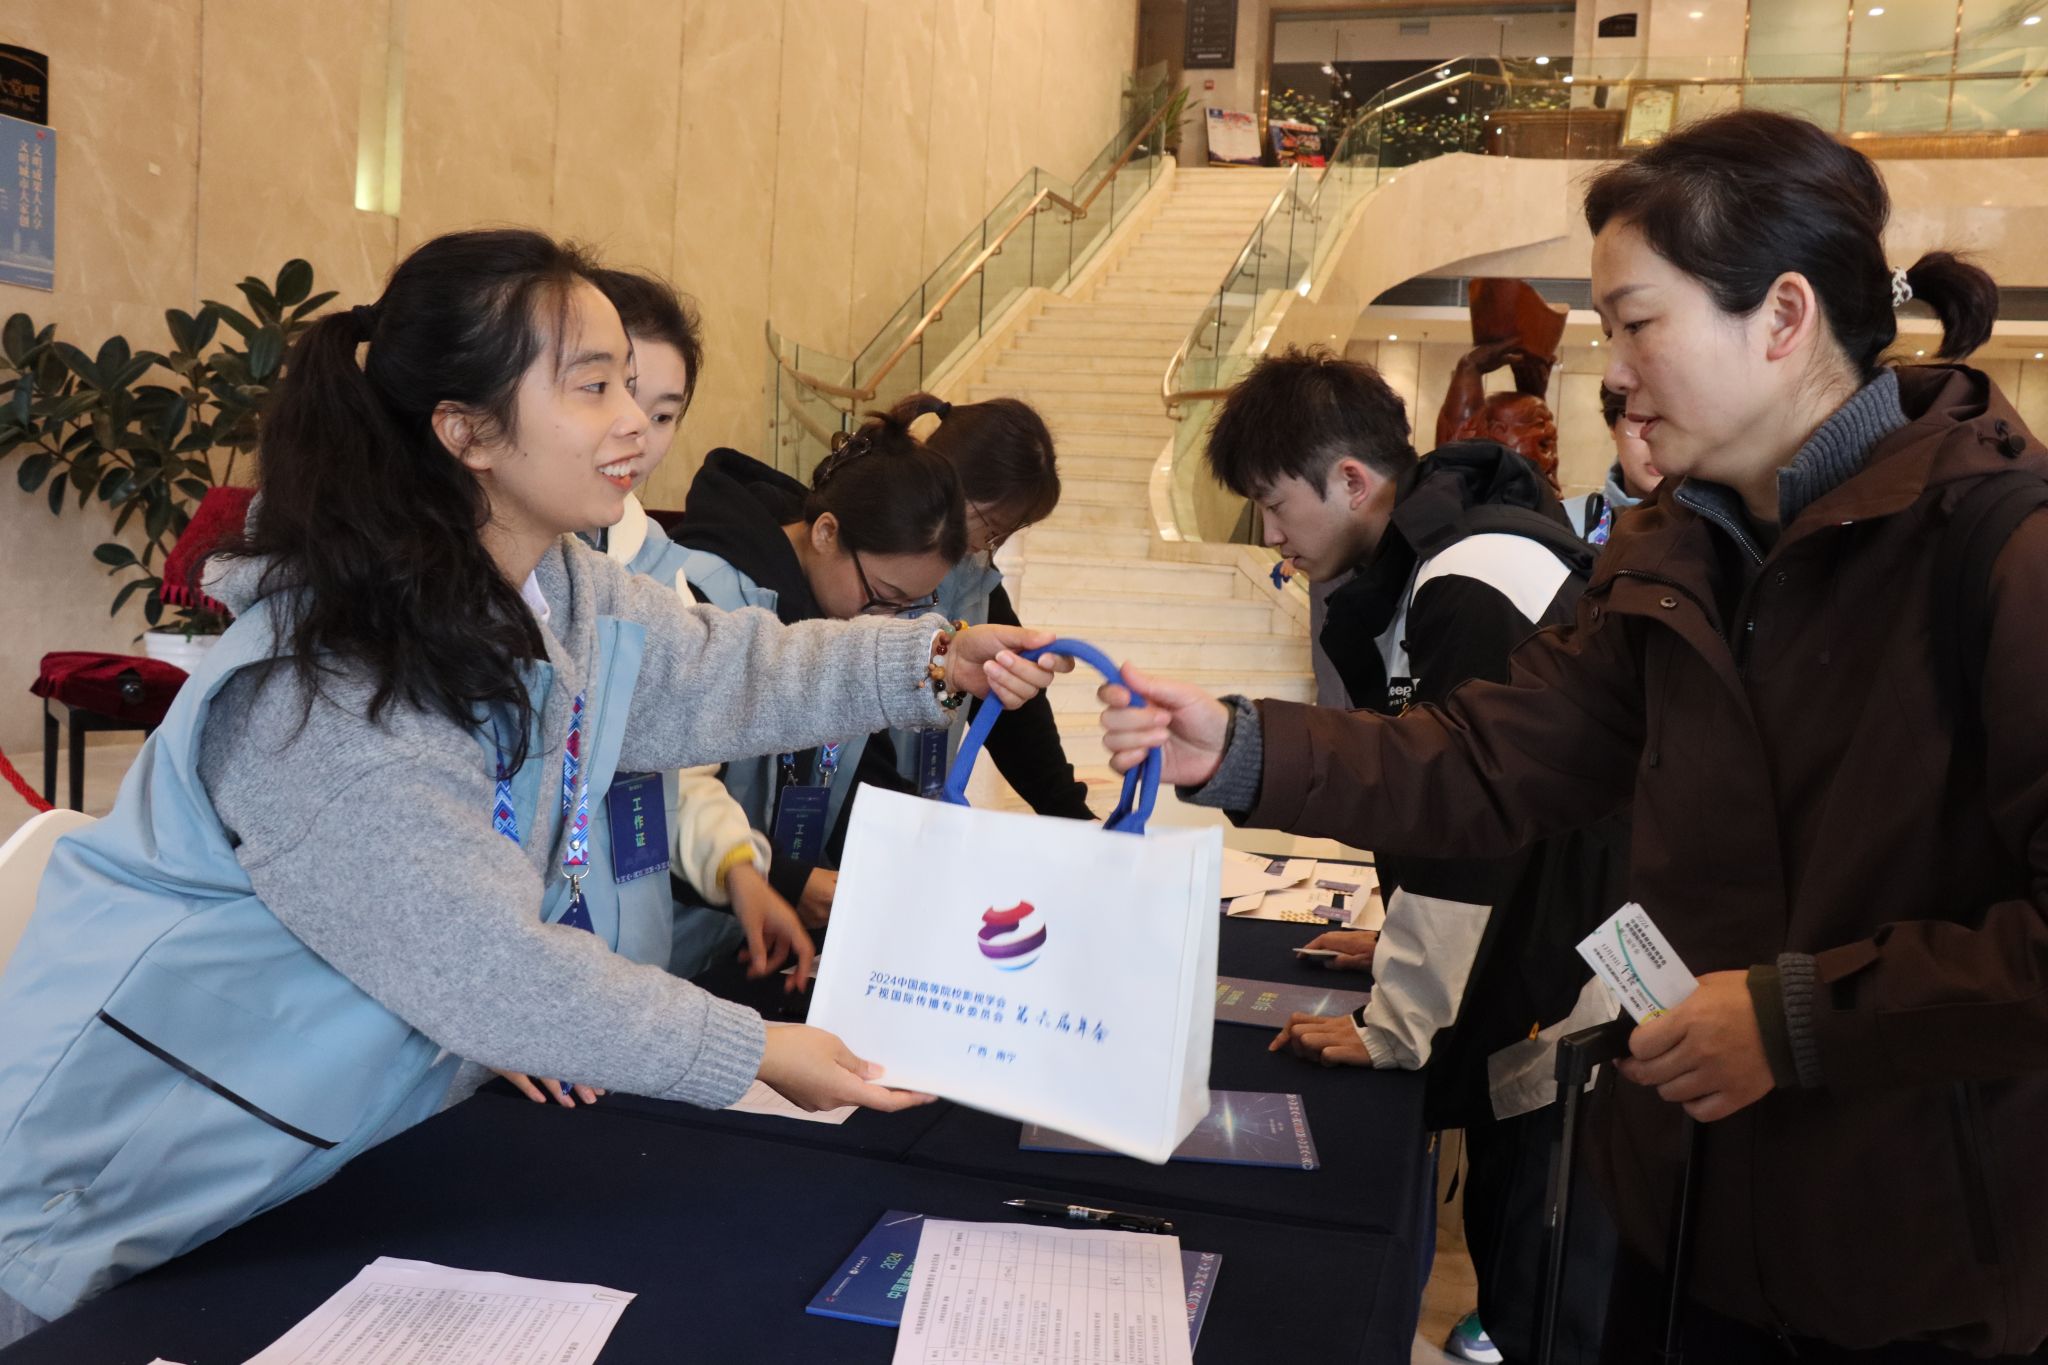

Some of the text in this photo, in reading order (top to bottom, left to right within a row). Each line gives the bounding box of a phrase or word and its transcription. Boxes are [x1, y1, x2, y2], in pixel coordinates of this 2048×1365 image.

[1389, 686, 1412, 696] eep
[632, 797, 646, 848] 工作证
[791, 824, 805, 860] 工作证
[870, 970, 1006, 1008] 2024中国高等院校影视学会
[880, 1252, 904, 1270] 2024
